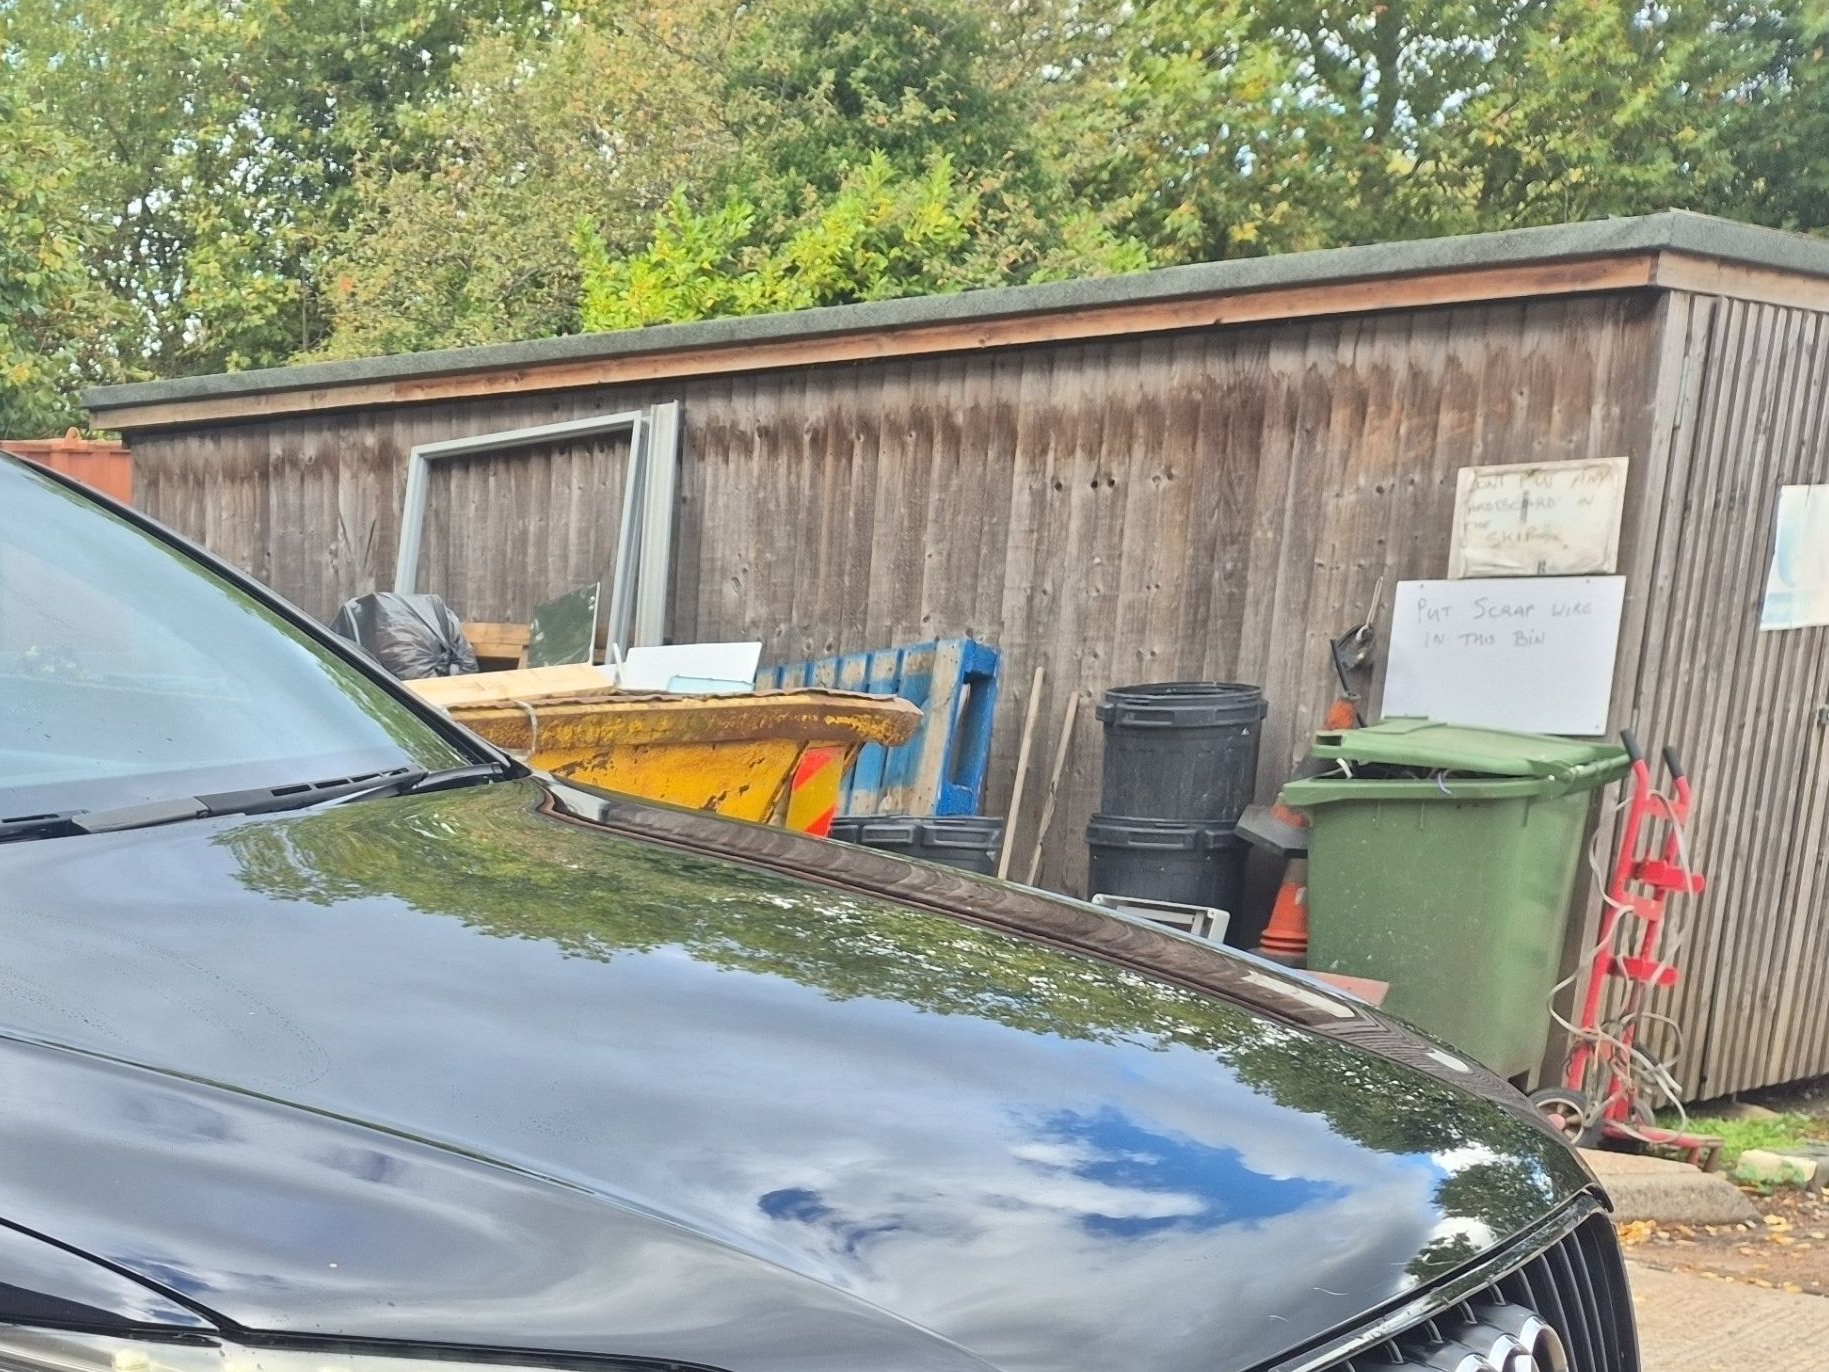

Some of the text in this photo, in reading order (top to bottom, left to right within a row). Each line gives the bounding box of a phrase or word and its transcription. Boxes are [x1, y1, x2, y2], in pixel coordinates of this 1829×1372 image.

[1417, 598, 1452, 623] PUT
[1473, 596, 1536, 619] SCRAP
[1424, 631, 1445, 648] IN
